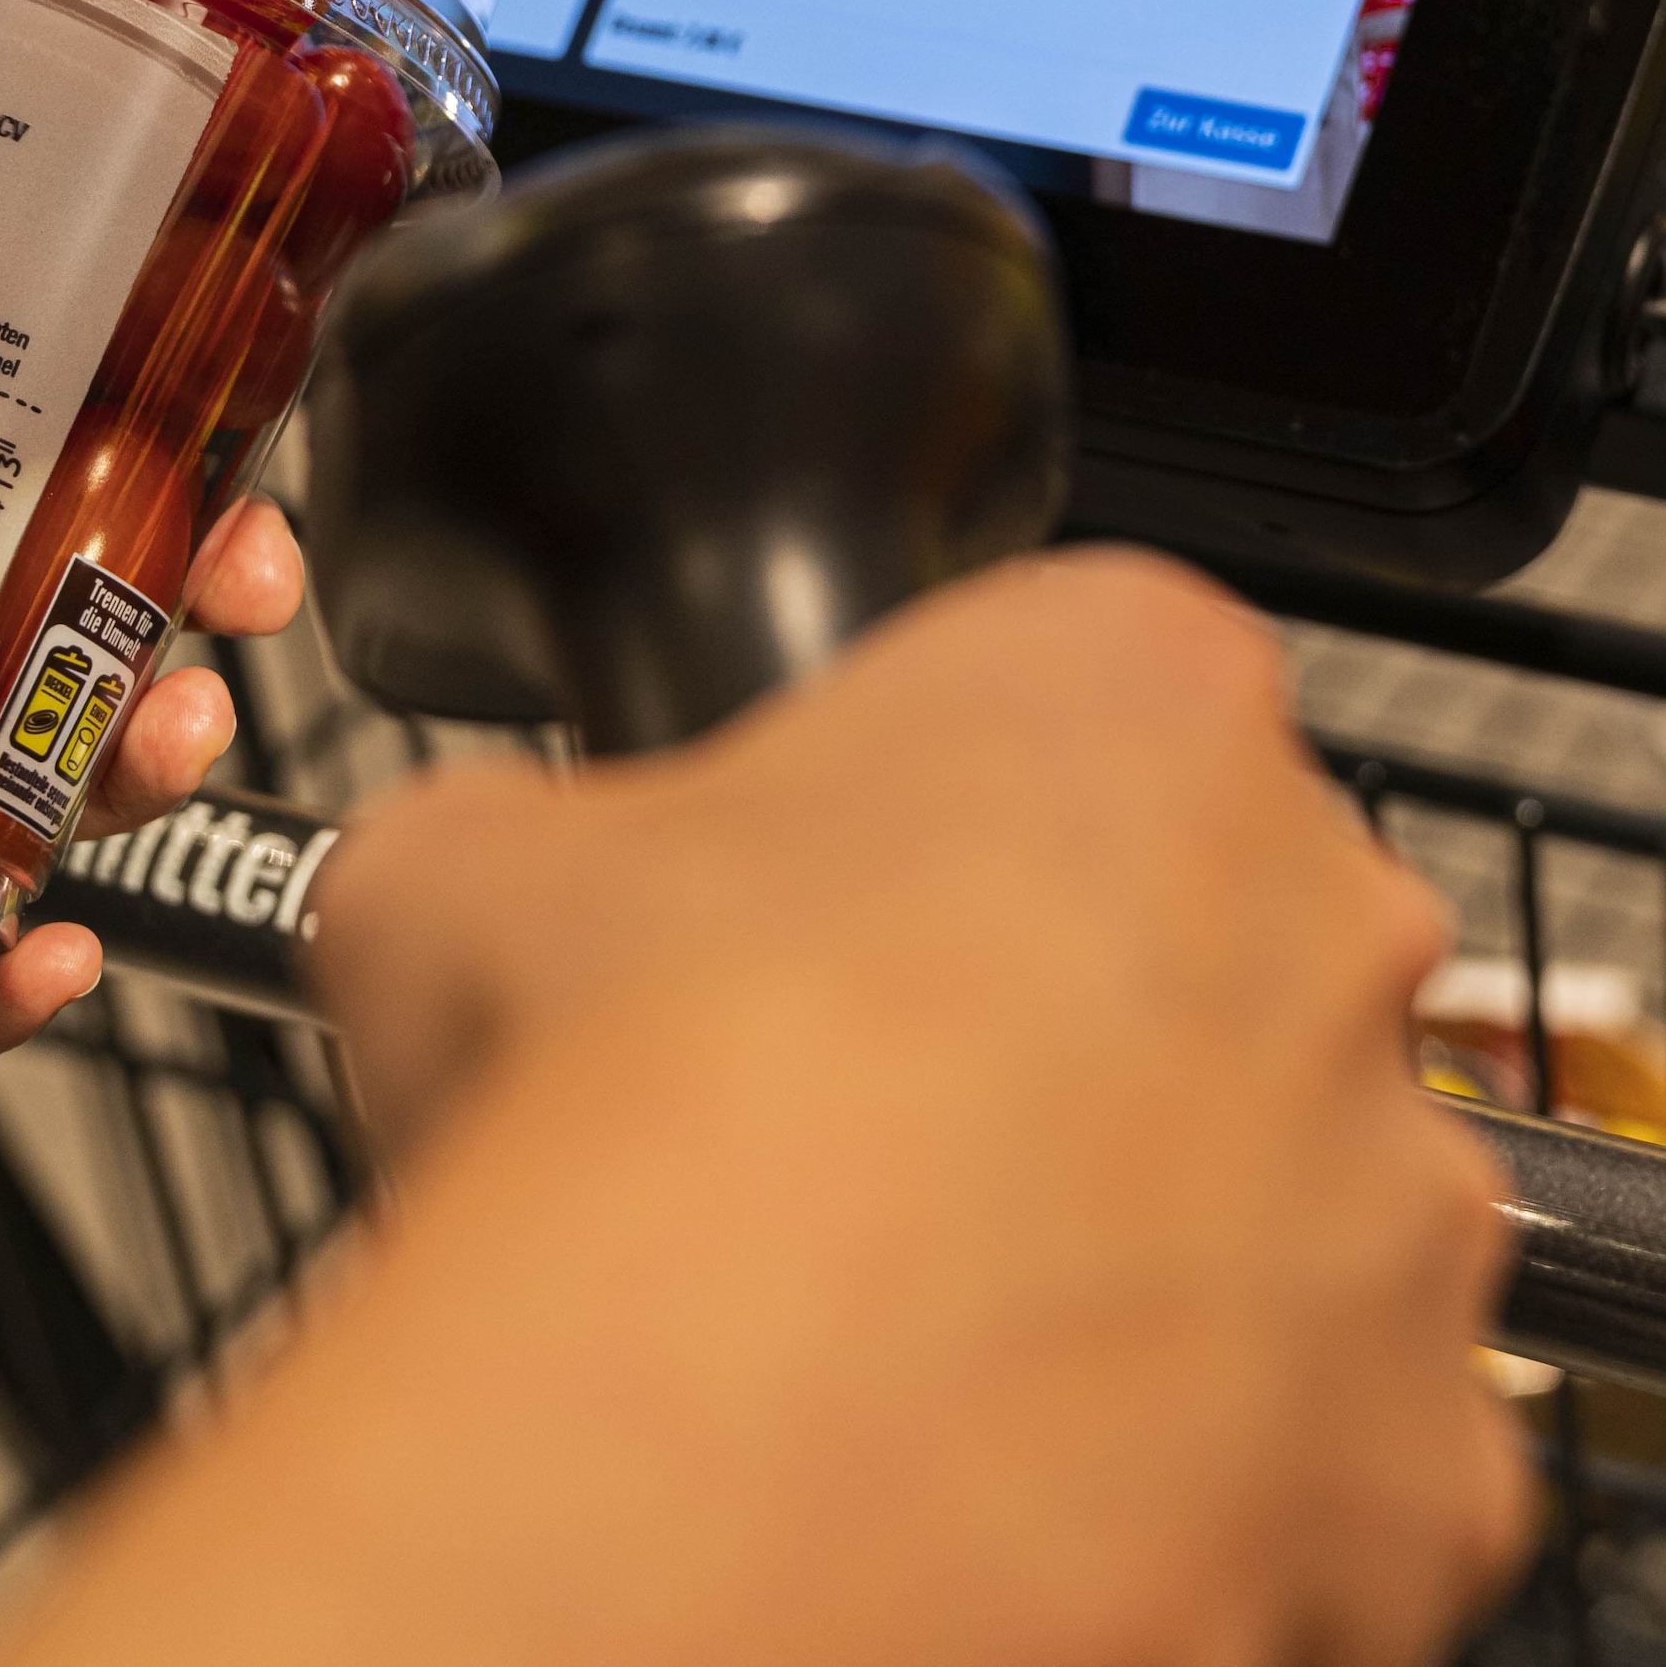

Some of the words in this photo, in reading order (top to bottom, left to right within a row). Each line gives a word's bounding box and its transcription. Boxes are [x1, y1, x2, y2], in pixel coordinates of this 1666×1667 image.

[79, 607, 101, 634] die
[101, 619, 142, 662] Umwelt
[89, 578, 137, 625] Trennen
[134, 609, 153, 638] für
[44, 673, 74, 701] DECKEL
